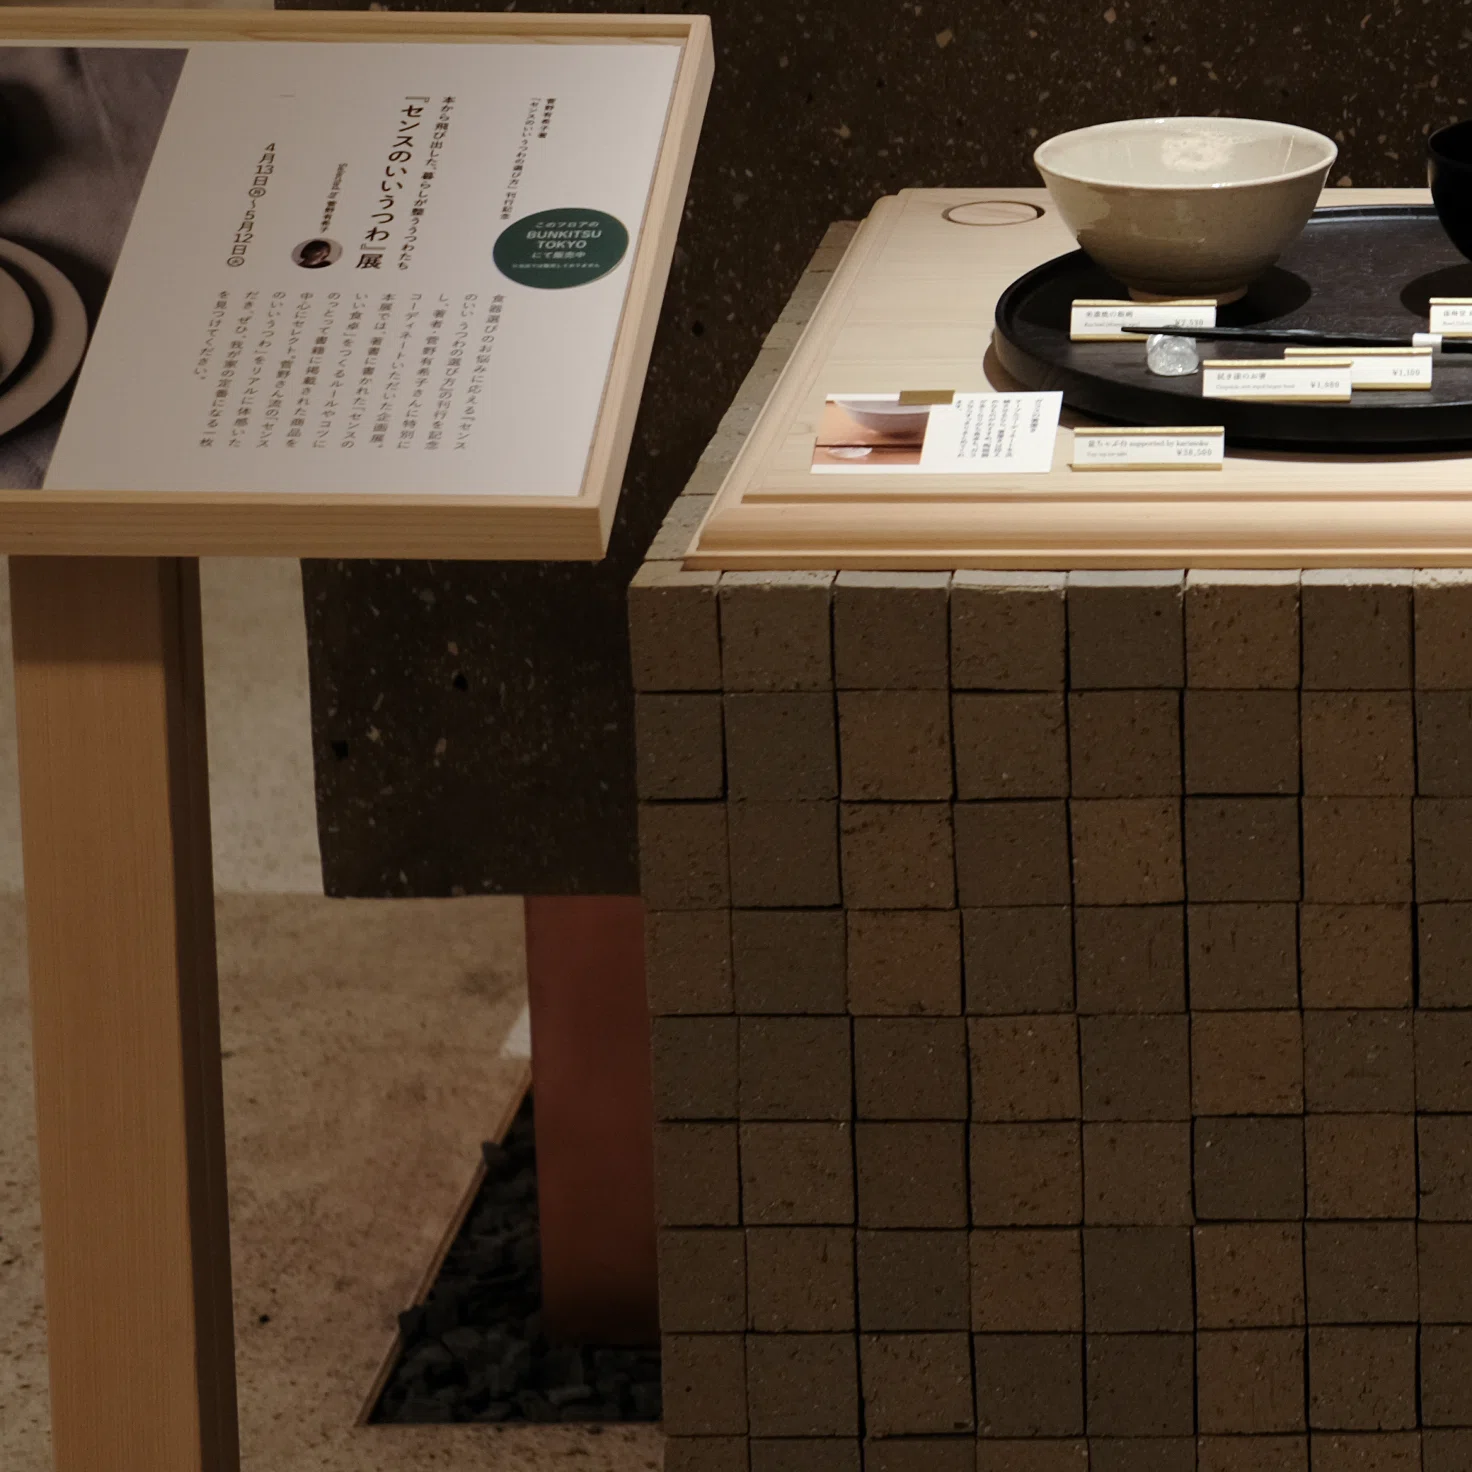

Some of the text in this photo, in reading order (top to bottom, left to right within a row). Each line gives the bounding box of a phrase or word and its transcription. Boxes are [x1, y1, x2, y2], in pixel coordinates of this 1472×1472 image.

[356, 96, 430, 269] 『センスのいいうつわ』展
[526, 229, 602, 239] BUNKITSU
[537, 239, 587, 249] TOKYO
[531, 251, 586, 259] にて販売中
[194, 291, 229, 379] を見つけてください。
[1129, 440, 1164, 448] supported
